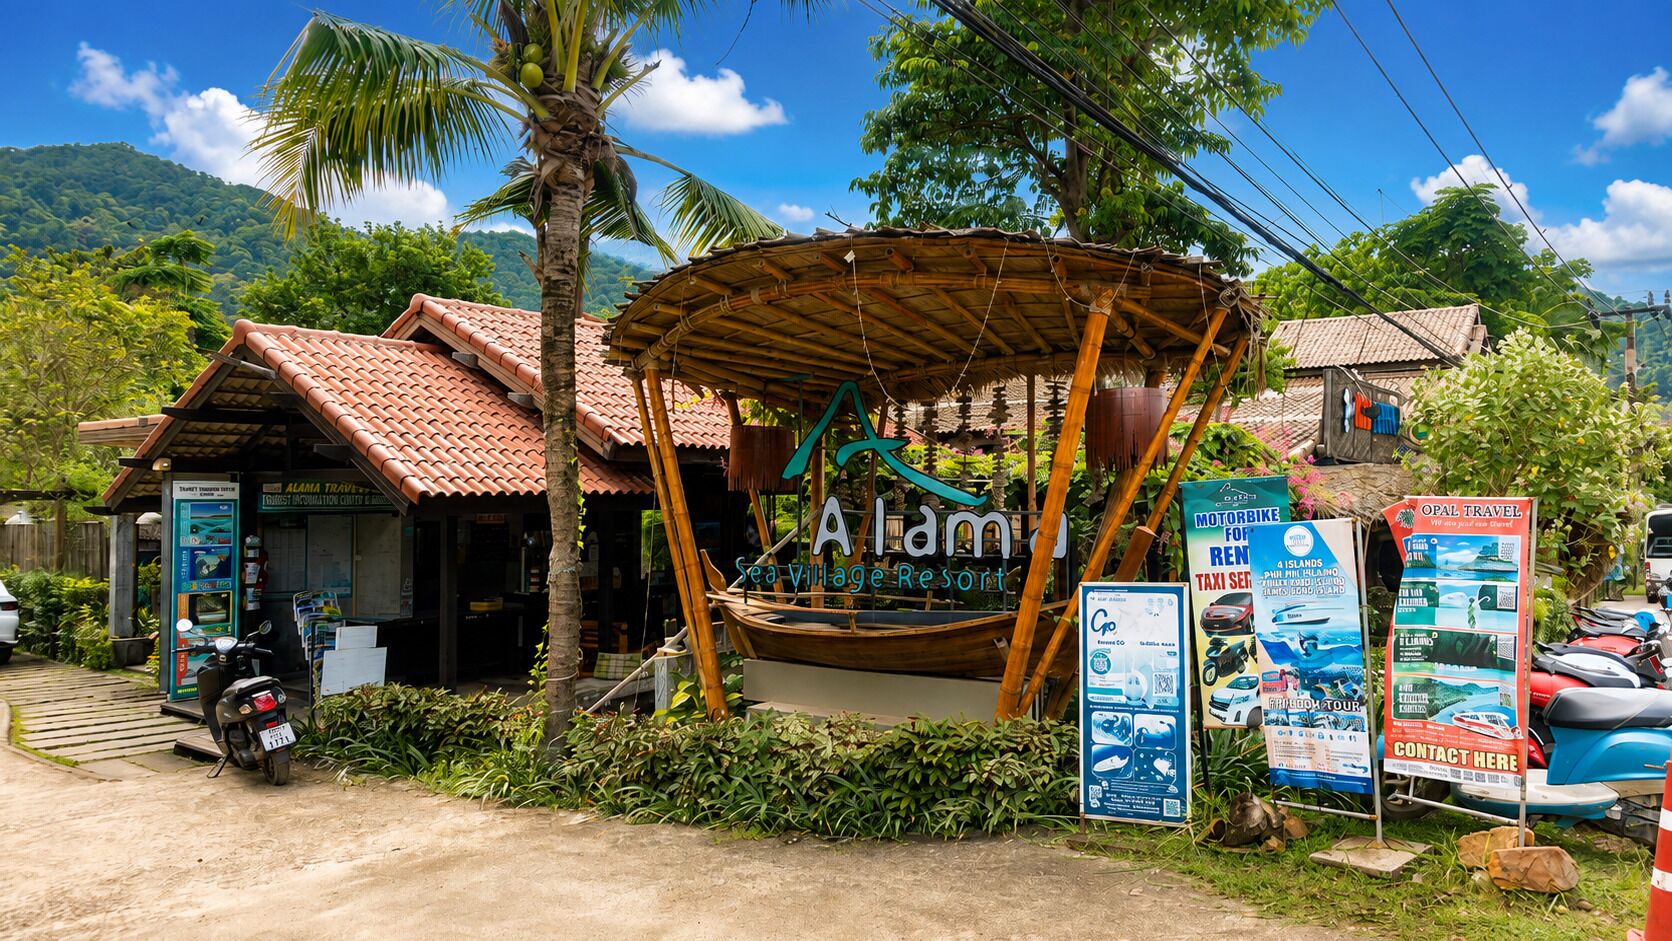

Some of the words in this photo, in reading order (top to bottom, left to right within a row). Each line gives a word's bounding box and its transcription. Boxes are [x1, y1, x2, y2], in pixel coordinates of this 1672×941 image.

[285, 483, 321, 494] ALAMA
[1195, 508, 1279, 528] MOTORBIKE
[1422, 503, 1459, 517] OPAL
[1463, 504, 1522, 518] TRAVEL
[1209, 545, 1249, 567] REN
[1285, 559, 1323, 569] ISLANDS
[735, 556, 776, 584] Sea
[788, 562, 885, 594] Village
[896, 562, 1005, 592] Resort
[1195, 572, 1226, 592] TAXI
[1326, 699, 1360, 712] TOUR
[1394, 741, 1470, 766] CONTACT
[1473, 750, 1519, 772] HERE
